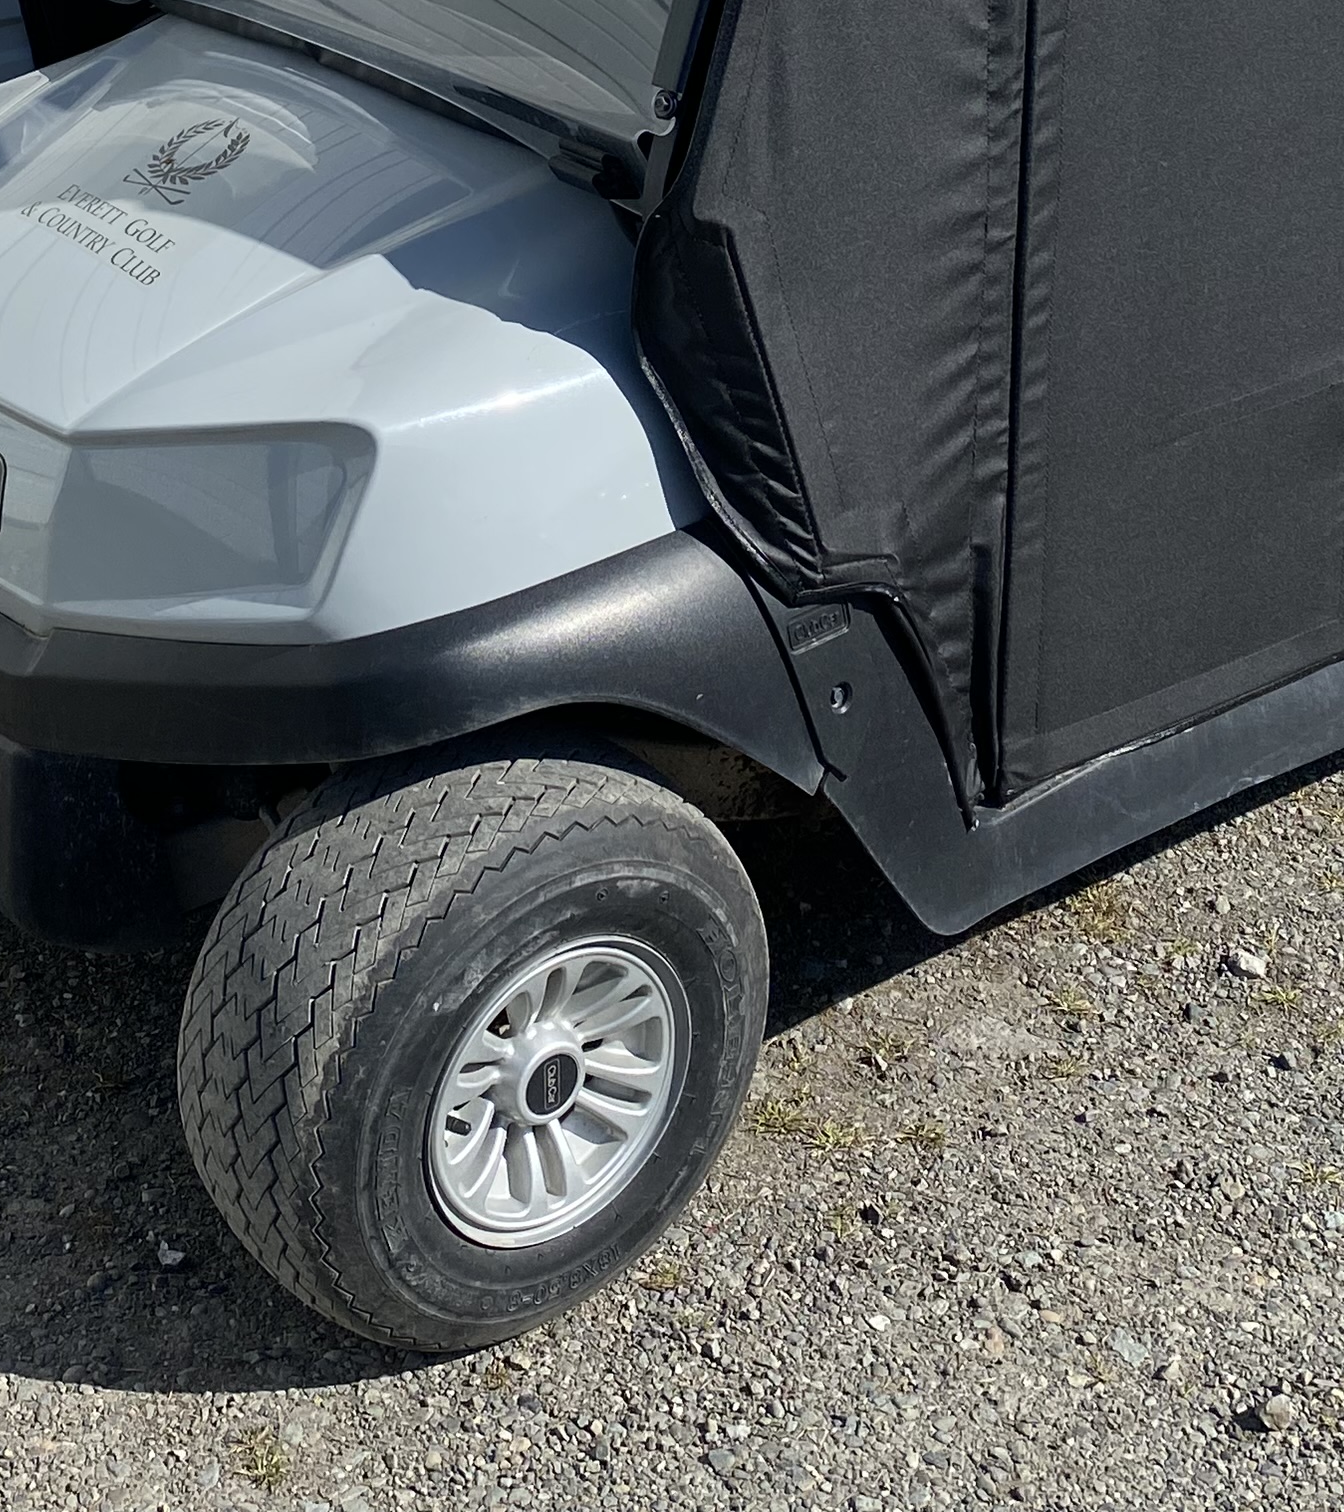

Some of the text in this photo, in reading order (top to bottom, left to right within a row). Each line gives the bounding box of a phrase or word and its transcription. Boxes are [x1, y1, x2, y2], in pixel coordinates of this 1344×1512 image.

[21, 200, 161, 286] & COUNTRY CLUB
[57, 185, 175, 253] EVERETT GOLF
